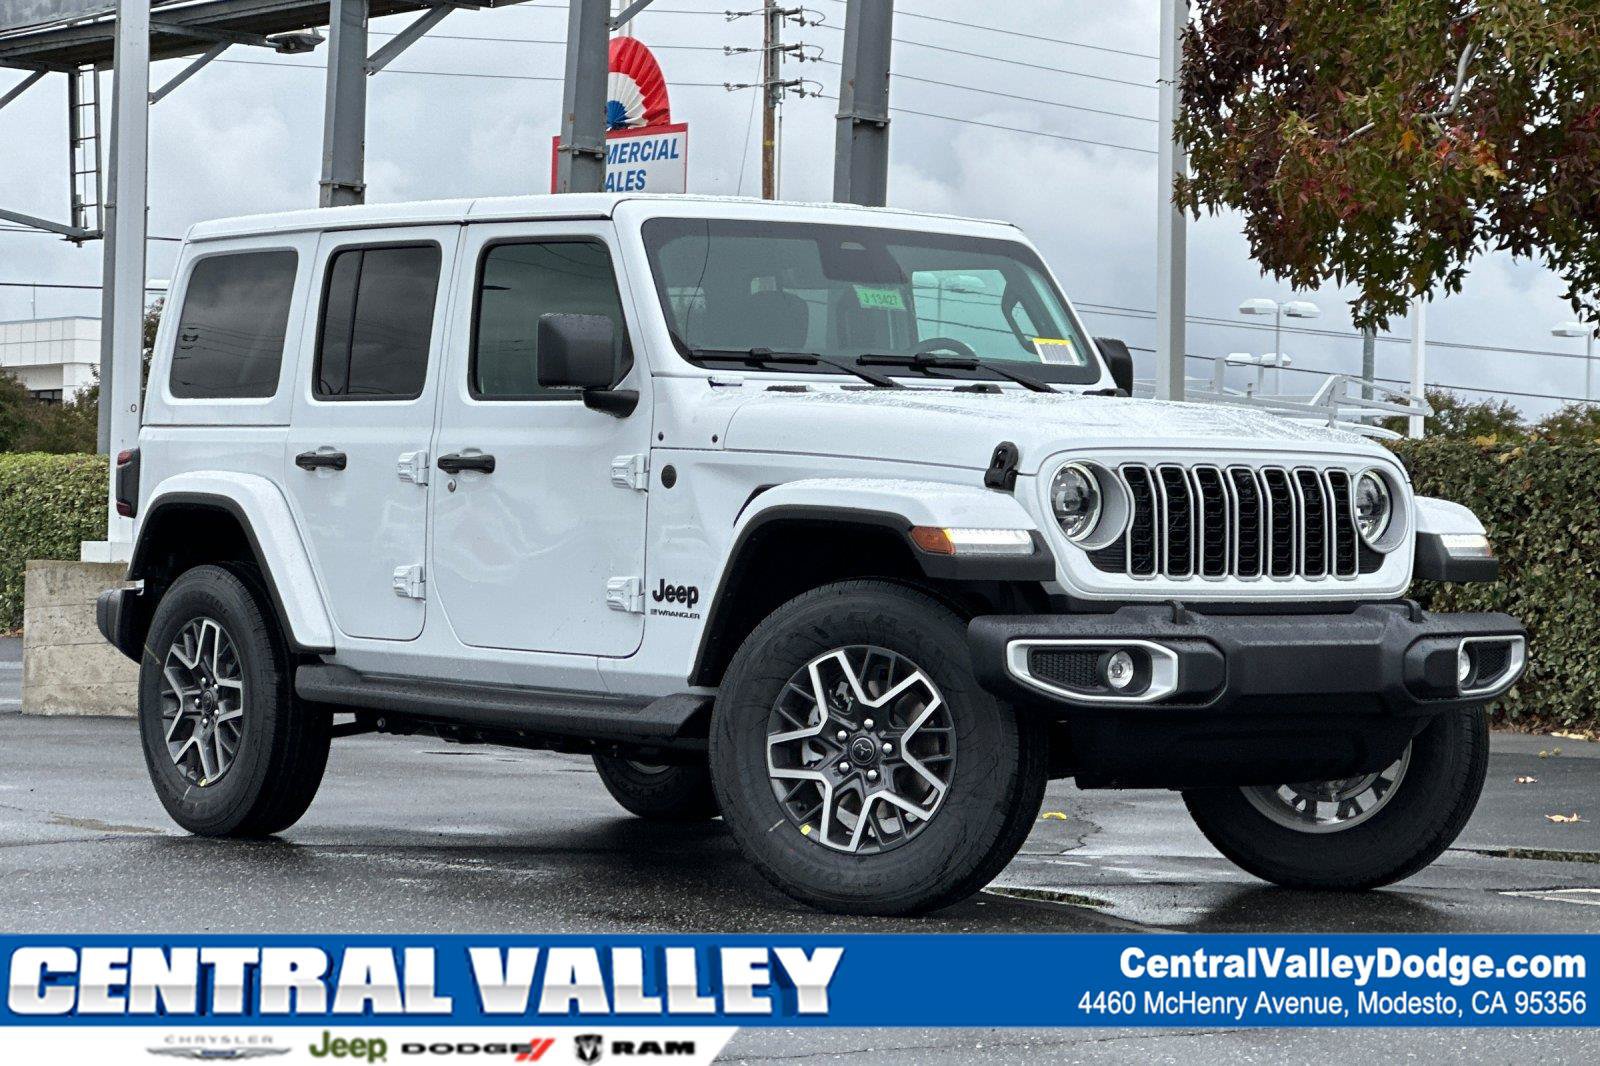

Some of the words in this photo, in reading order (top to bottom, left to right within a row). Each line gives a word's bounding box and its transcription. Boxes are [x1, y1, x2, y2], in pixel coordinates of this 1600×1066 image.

[606, 138, 679, 164] MERCIAL
[605, 169, 647, 192] ALES
[652, 578, 699, 609] Jeep
[657, 609, 700, 620] WRANGLER
